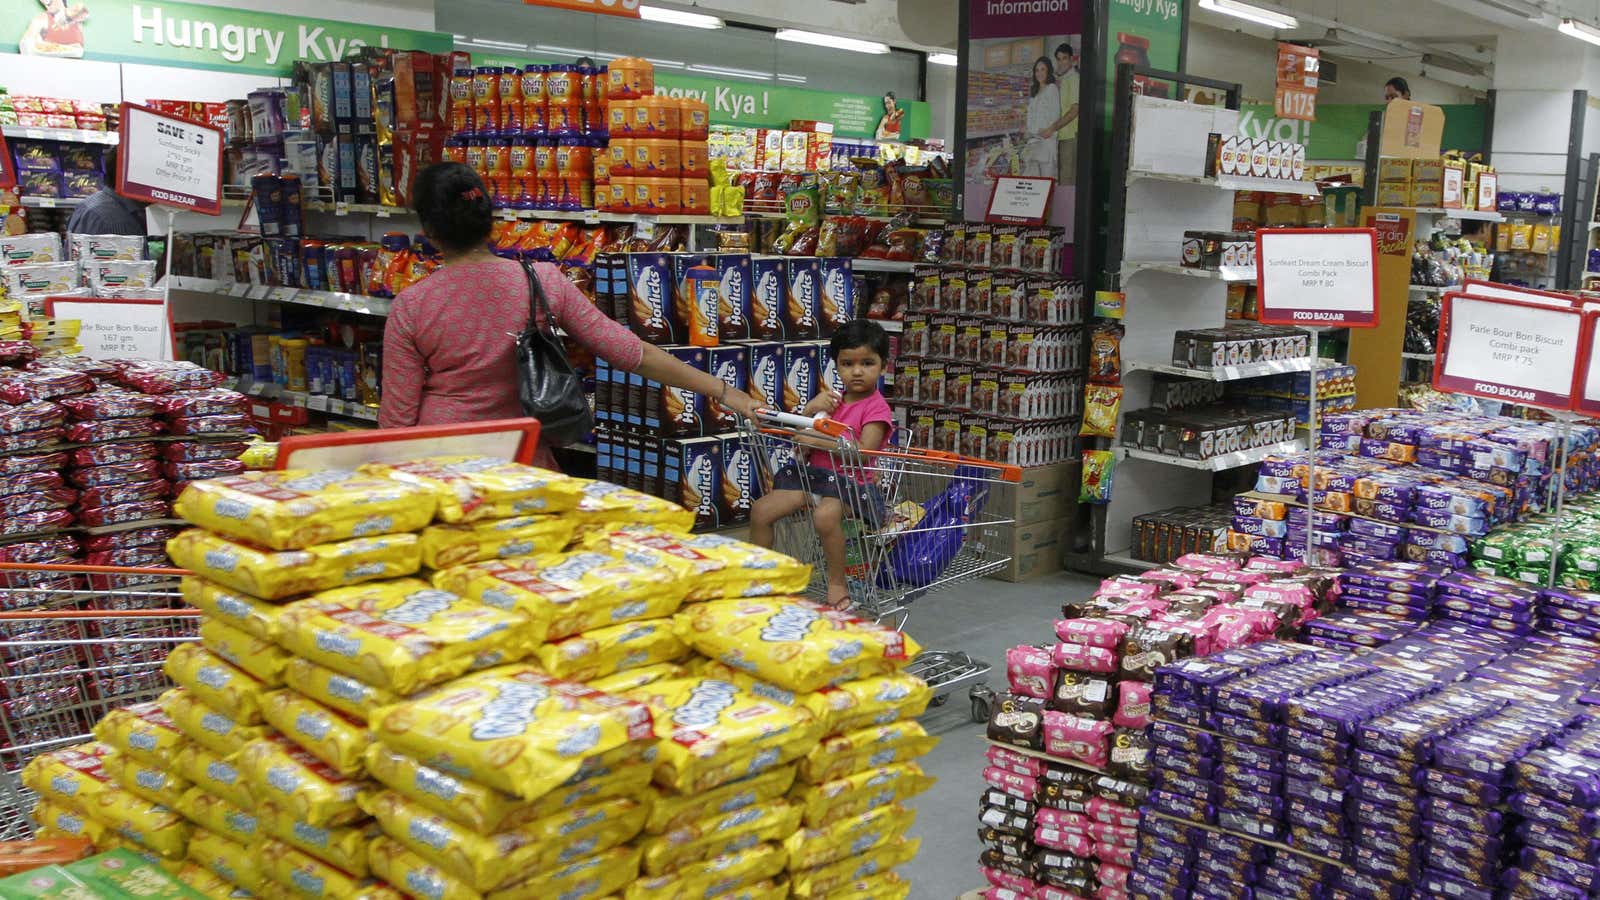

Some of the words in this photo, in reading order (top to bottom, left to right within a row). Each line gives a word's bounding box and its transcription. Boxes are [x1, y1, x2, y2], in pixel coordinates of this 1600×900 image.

[987, 0, 1068, 16] Information
[132, 5, 284, 64] Hungry
[715, 87, 755, 121] Kya
[157, 122, 185, 139] SAVE
[368, 148, 377, 194] Horlicks
[151, 189, 169, 200] FOOD
[169, 193, 196, 206] BAZAAR
[966, 225, 991, 234] Complan
[993, 225, 1018, 235] Complan
[1024, 228, 1050, 238] Complan
[1268, 259, 1297, 267] Sunfeast
[1299, 259, 1320, 267] Dream
[1322, 259, 1345, 267] Cream
[914, 268, 939, 278] Complan
[940, 271, 966, 280] Complan
[967, 272, 992, 282] Complan
[992, 277, 1016, 286] Complan
[1027, 280, 1052, 289] Complan
[648, 268, 663, 329] Horlicks
[732, 271, 742, 326] Horlicks
[767, 271, 779, 329] Horlicks
[802, 273, 814, 327] Horlicks
[838, 270, 848, 324] Horlicks
[707, 290, 719, 337] Horlicks
[903, 314, 926, 323] Complan
[1293, 311, 1313, 320] FOOD
[1314, 312, 1345, 321] BAZAAR
[931, 316, 956, 325] Complan
[956, 318, 982, 327] Complan
[981, 322, 1007, 332] Complan
[1008, 325, 1035, 334] Complan
[103, 334, 117, 342] 167
[120, 335, 133, 343] gm
[1470, 324, 1491, 334] Parle
[1493, 327, 1514, 338] Bour
[1516, 331, 1533, 342] Bon
[1535, 334, 1564, 346] Biscuit
[100, 343, 118, 351] MRP
[127, 344, 137, 352] 25
[1489, 339, 1518, 350] Combi
[1519, 344, 1540, 355] pack
[895, 359, 919, 368] Complan
[1492, 352, 1513, 361] MRP
[1522, 357, 1534, 366] 75
[921, 361, 945, 370] Complan
[946, 364, 972, 374] Complan
[972, 370, 998, 380] Complan
[1000, 374, 1026, 383] Complan
[1474, 383, 1500, 394] FOOD
[1500, 386, 1537, 401] BAZAAR
[910, 407, 934, 417] Complan
[934, 412, 960, 421] Complan
[960, 416, 987, 426] Complan
[988, 421, 1014, 430] Complan
[1274, 468, 1292, 477] Fob!
[739, 449, 751, 509] Horlicks
[700, 458, 712, 516] Horlicks
[1430, 499, 1449, 508] Fob!
[1430, 518, 1450, 526] Fob!
